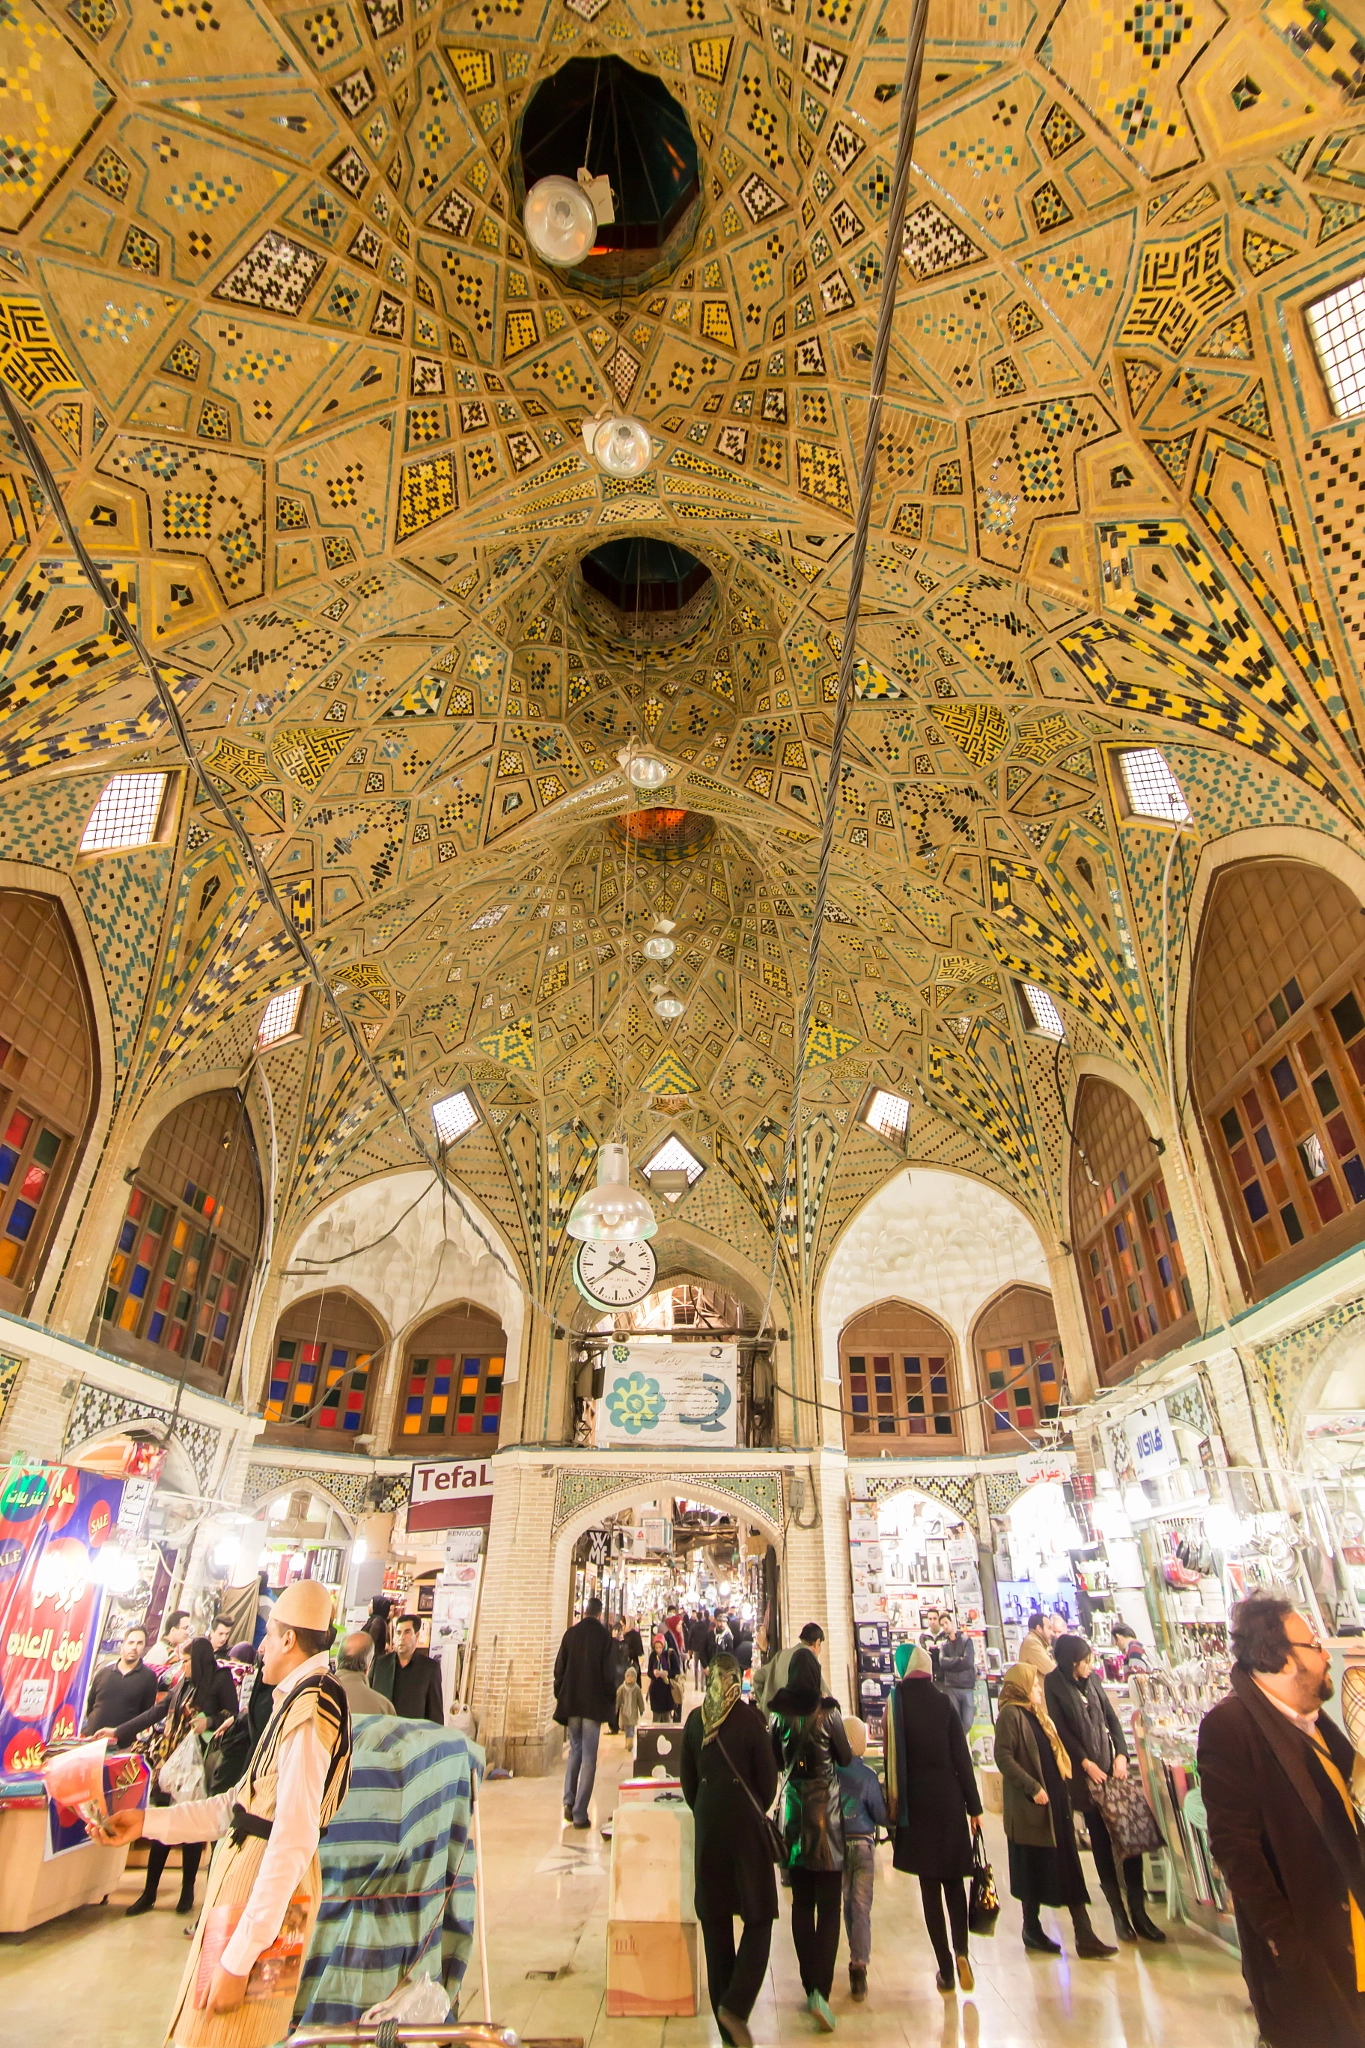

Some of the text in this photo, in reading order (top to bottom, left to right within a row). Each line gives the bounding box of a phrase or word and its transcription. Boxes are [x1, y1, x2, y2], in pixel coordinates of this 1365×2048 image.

[1025, 1466, 1067, 1484] زعفرانی
[91, 1513, 109, 1534] SALE
[448, 1530, 482, 1538] KENWOOD
[6, 1627, 84, 1673] فوق العاده
